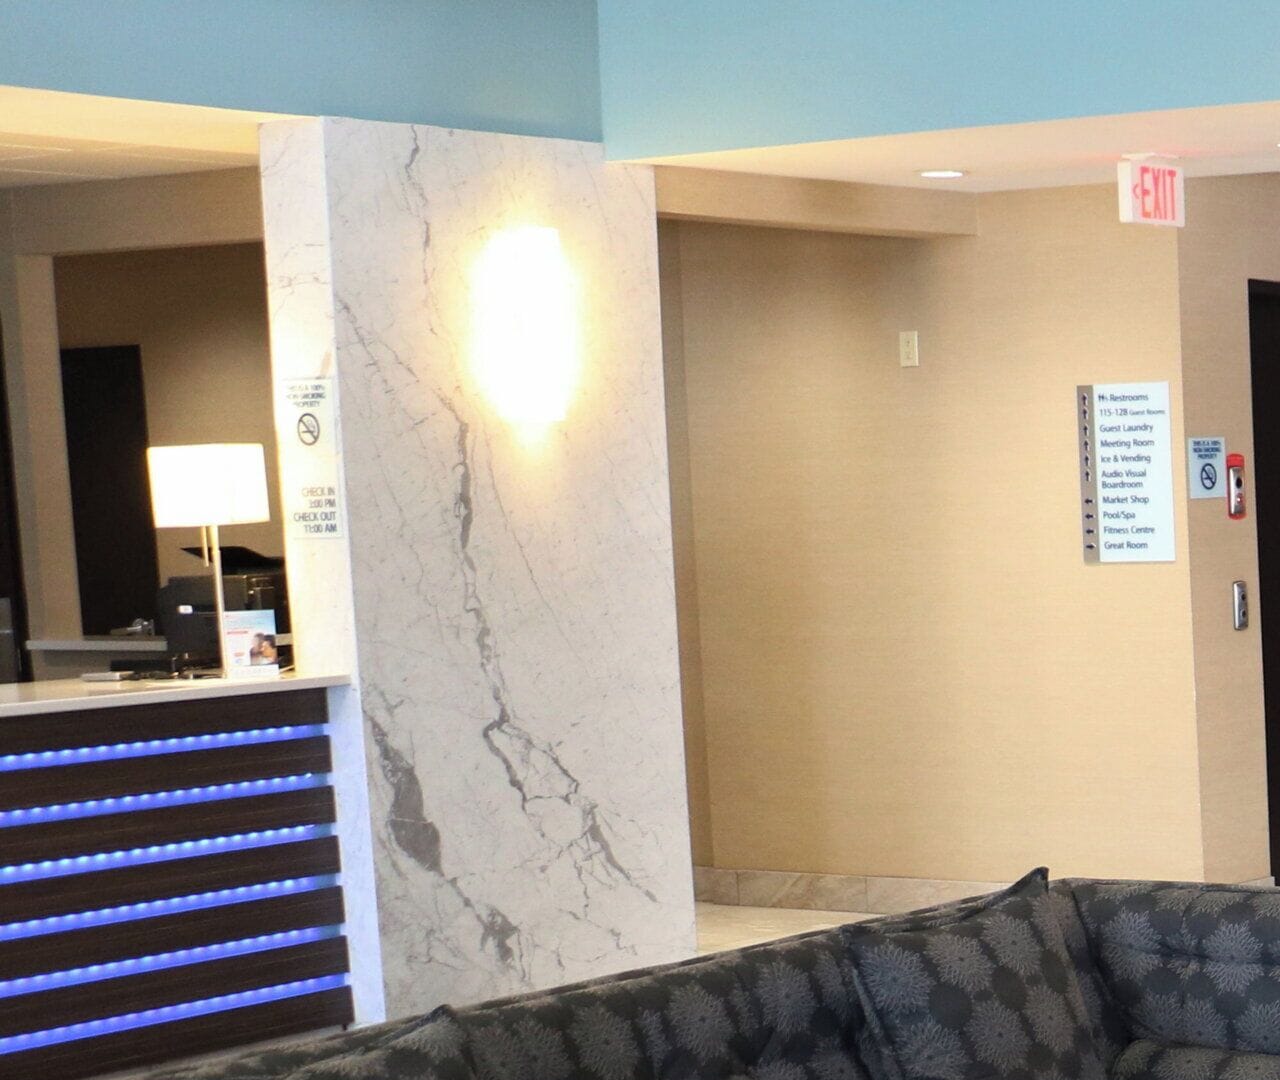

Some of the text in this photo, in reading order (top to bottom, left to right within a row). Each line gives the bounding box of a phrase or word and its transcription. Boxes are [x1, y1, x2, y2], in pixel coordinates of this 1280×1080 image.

[1140, 166, 1177, 221] EXIT
[1109, 393, 1149, 402] Restrooms
[1100, 408, 1128, 417] 115-128
[1100, 423, 1153, 433] Guest Laundry
[1100, 438, 1155, 449] Meeting Room
[1101, 453, 1151, 464] Ice & Vending
[1101, 468, 1147, 478] Audio Visual
[1102, 480, 1144, 489] Boardroom
[301, 486, 336, 497] CHECK IN
[324, 498, 337, 508] PM
[1102, 495, 1150, 505] Market Shop
[293, 511, 337, 521] CHECK OUT
[1103, 511, 1136, 521] Pool/Spa
[324, 523, 338, 533] AM
[1103, 525, 1156, 534] Fitness Centre
[1104, 541, 1149, 550] Great Room
